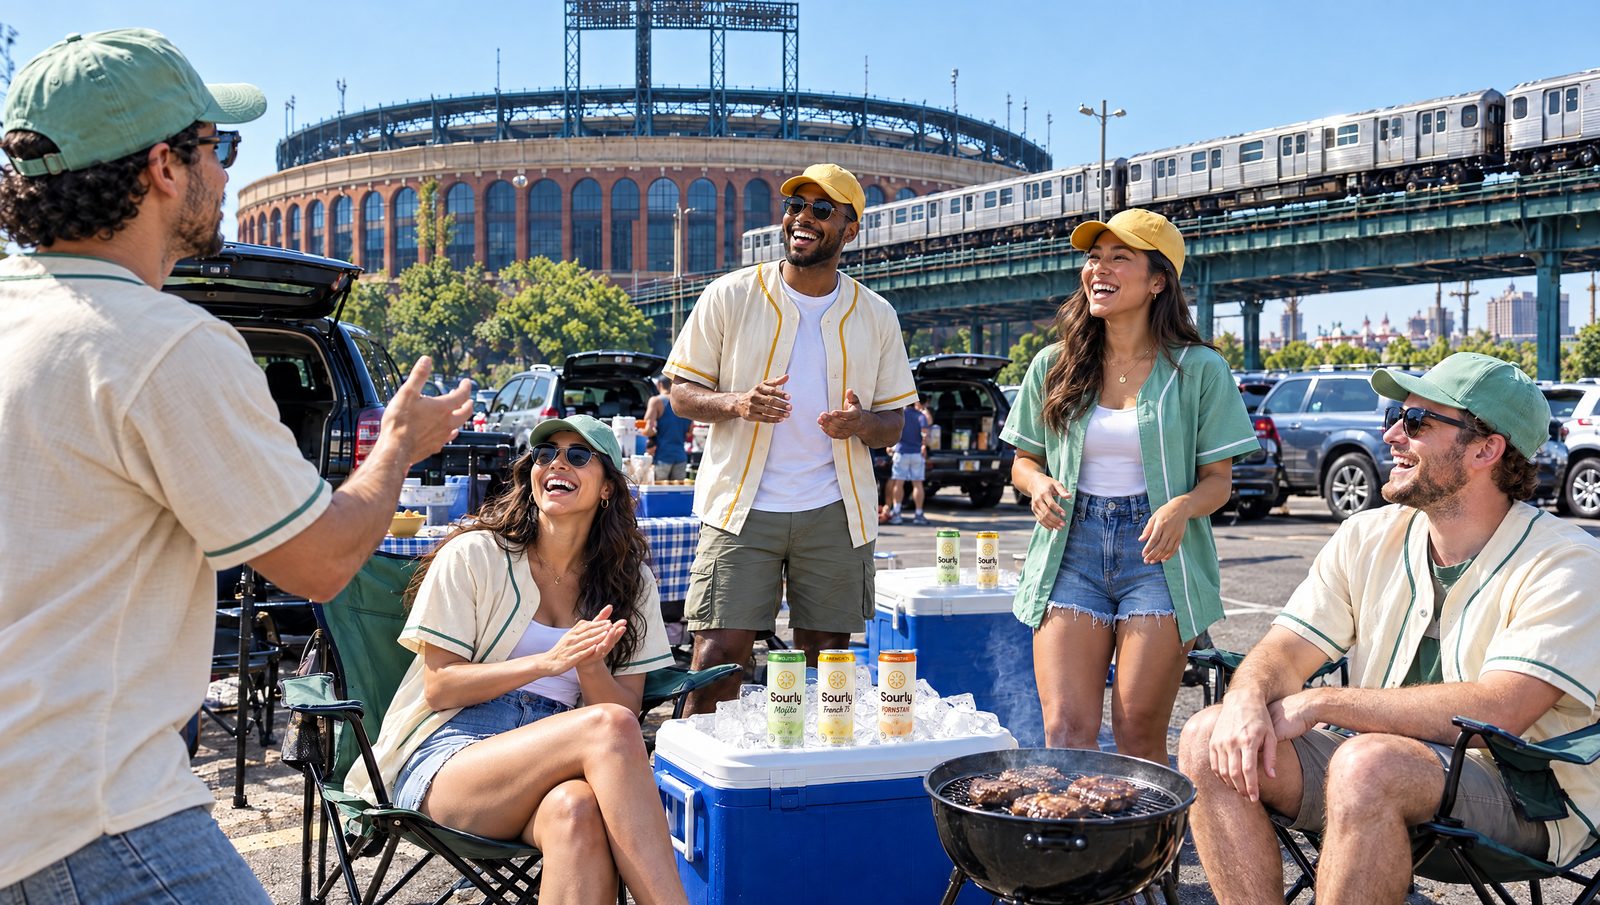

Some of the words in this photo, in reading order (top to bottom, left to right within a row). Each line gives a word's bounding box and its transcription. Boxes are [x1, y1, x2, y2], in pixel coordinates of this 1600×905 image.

[938, 556, 957, 565] Sourly
[978, 556, 997, 565] Sourly
[770, 691, 802, 705] Sourly
[821, 691, 853, 705] Sourly
[880, 691, 913, 705] Sourly
[773, 705, 797, 717] Mojito
[823, 705, 843, 714] French
